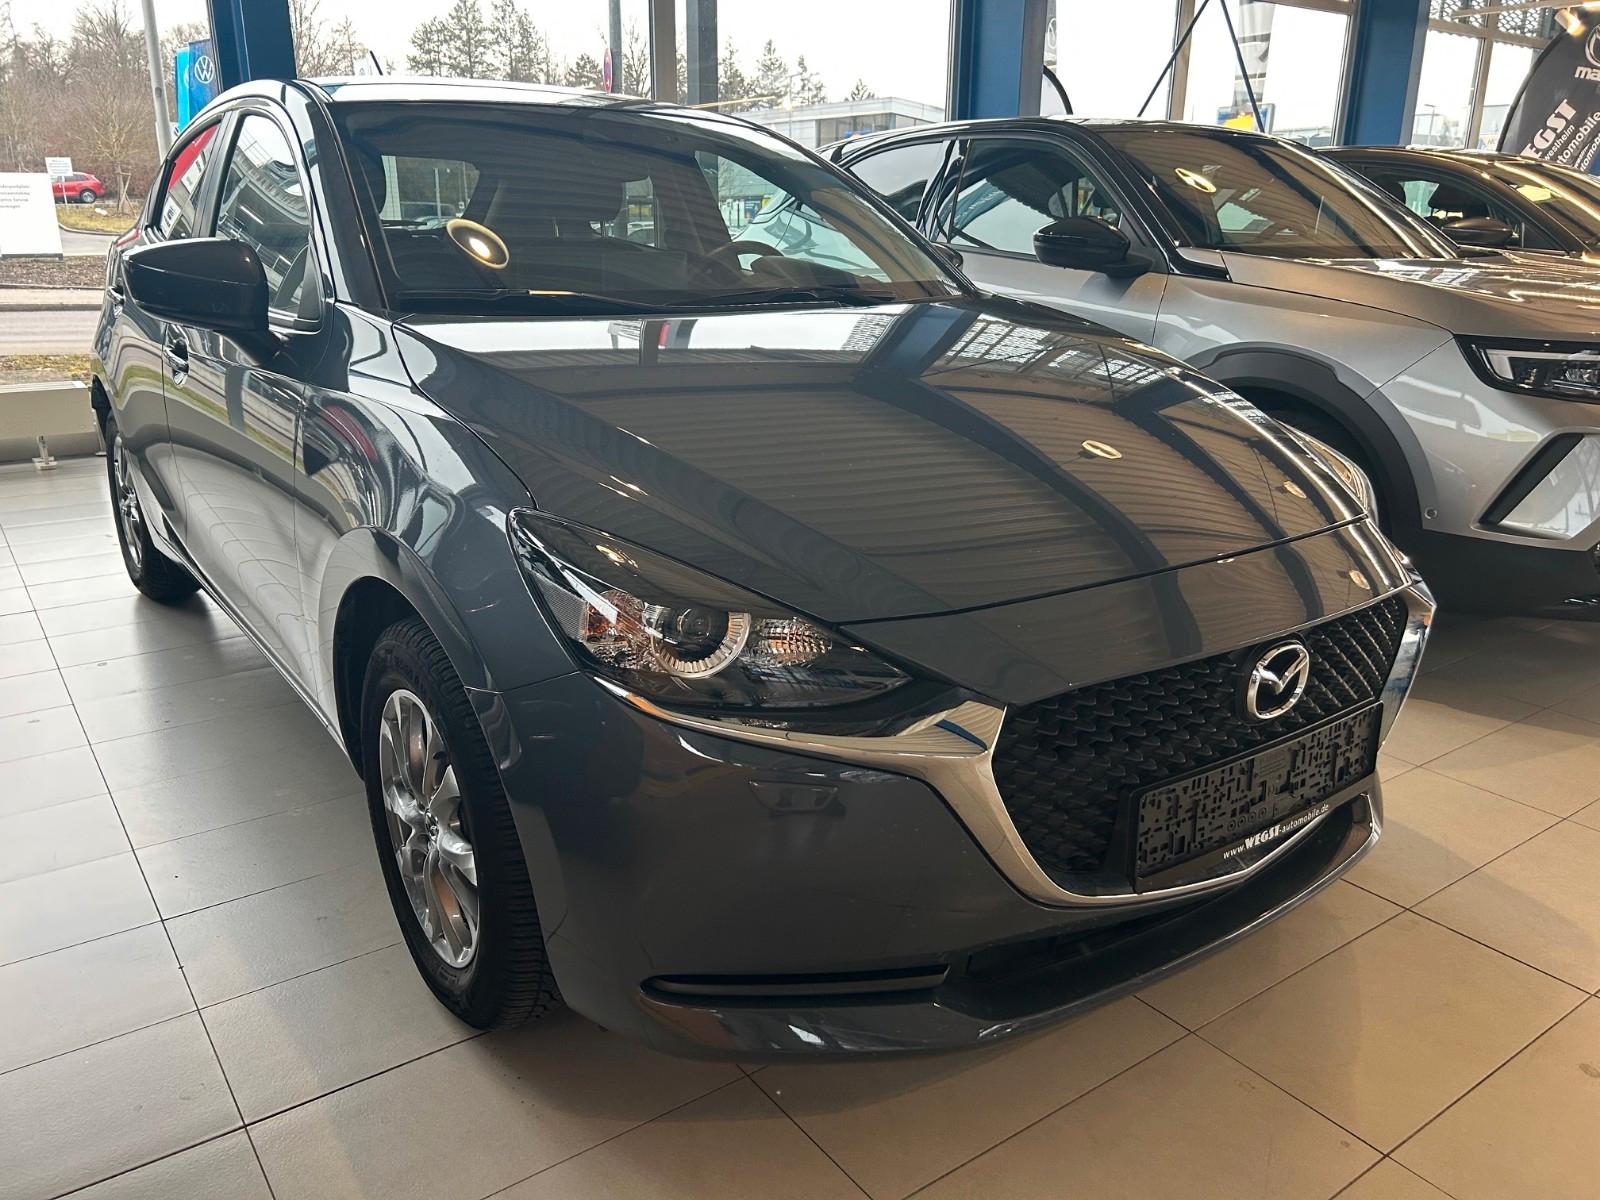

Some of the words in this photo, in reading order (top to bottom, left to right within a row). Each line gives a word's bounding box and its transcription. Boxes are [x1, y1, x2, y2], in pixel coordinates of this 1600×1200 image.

[1574, 66, 1600, 82] ma
[1520, 99, 1577, 159] EGST
[1544, 125, 1576, 161] westheim
[1223, 803, 1330, 860] www.WEGST-automobile.de
